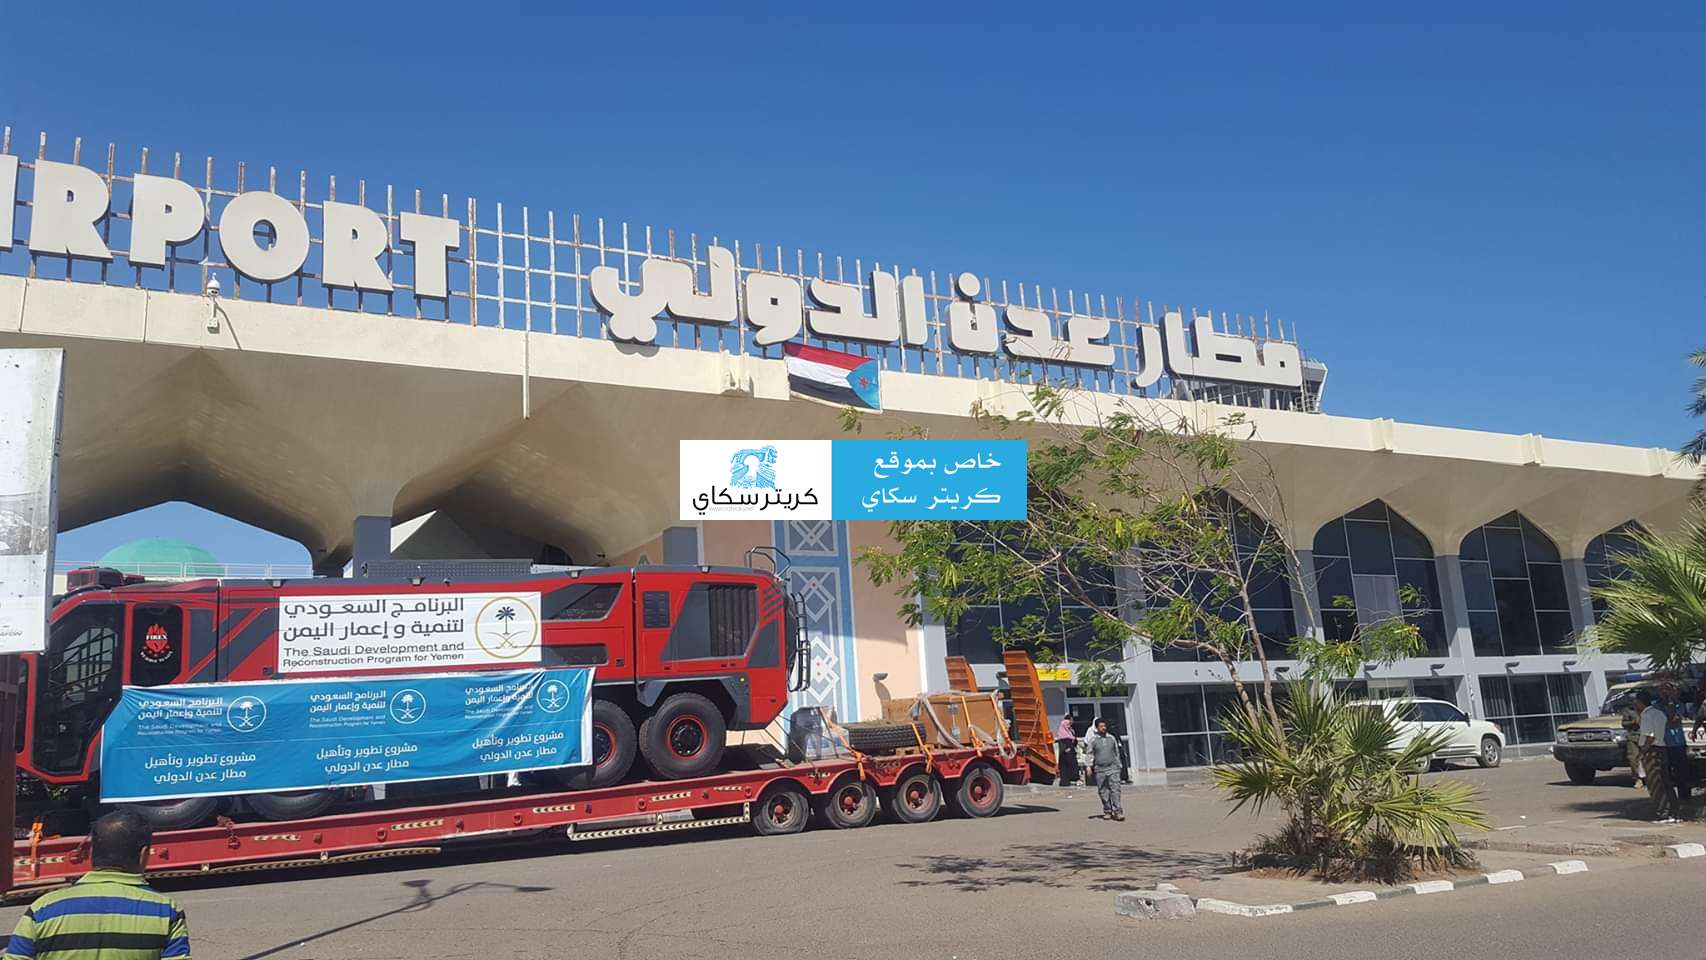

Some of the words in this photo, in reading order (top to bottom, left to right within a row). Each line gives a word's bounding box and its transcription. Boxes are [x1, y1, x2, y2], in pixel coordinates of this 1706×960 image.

[588, 244, 928, 345] الدولي
[947, 271, 1116, 368] عدن
[1130, 310, 1303, 390] مطار
[284, 599, 387, 619] السعودي
[283, 621, 334, 642] اليمن
[337, 620, 389, 641] إعمار
[410, 618, 464, 637] لتنمية
[283, 646, 310, 657] The
[312, 645, 351, 657] Saudi
[354, 642, 438, 655] Development
[441, 641, 464, 651] and
[283, 656, 364, 668] Reconstruction
[366, 654, 411, 665] Program
[414, 653, 428, 662] for
[430, 652, 464, 661] Yemen
[309, 703, 333, 714] اليمن
[472, 734, 504, 750] وتأهيل
[507, 733, 532, 747] تطوير
[533, 731, 565, 744] مشروع
[316, 744, 352, 760] وتأهيل
[353, 744, 383, 759] تطوير
[384, 742, 418, 757] مشروع
[479, 750, 513, 763] الدولي
[514, 749, 534, 759] عدن
[535, 747, 558, 759] مطار
[144, 753, 184, 770] وتأهيل
[186, 753, 218, 768] تطوير
[219, 752, 257, 767] مشروع
[384, 759, 410, 772] مطار
[324, 761, 360, 775] الدولي
[362, 762, 383, 773] عدن
[153, 771, 193, 785] الدولي
[195, 771, 218, 783] عدن
[220, 769, 247, 782] مطار
